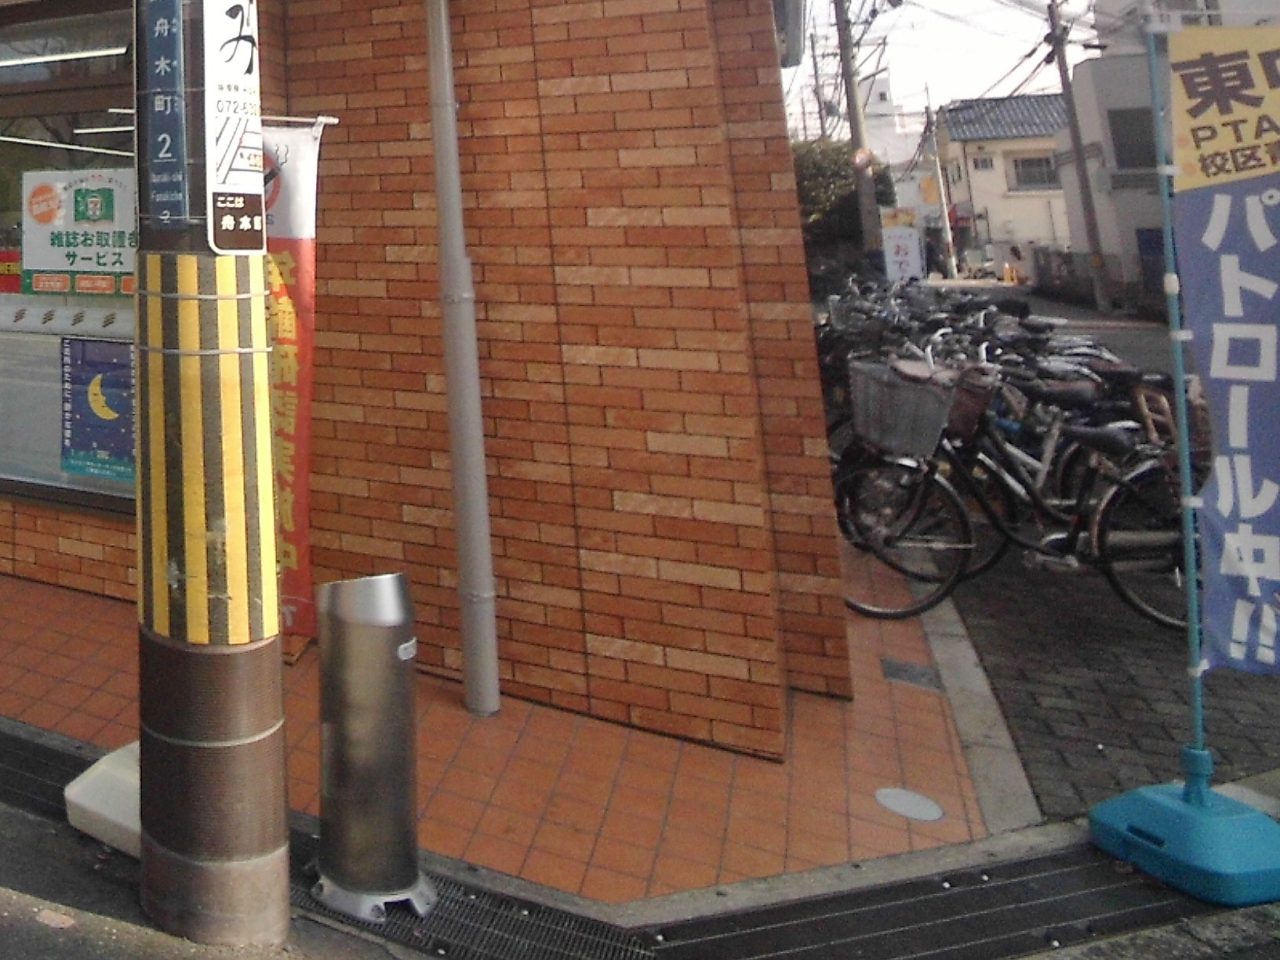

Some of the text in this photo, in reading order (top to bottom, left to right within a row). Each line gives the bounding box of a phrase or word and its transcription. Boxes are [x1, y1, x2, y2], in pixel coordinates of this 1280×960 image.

[153, 17, 173, 159] 舟木町 2
[1171, 48, 1280, 119] 東
[1191, 114, 1280, 150] PTA
[216, 196, 245, 209] ここは
[65, 251, 123, 267] サービス
